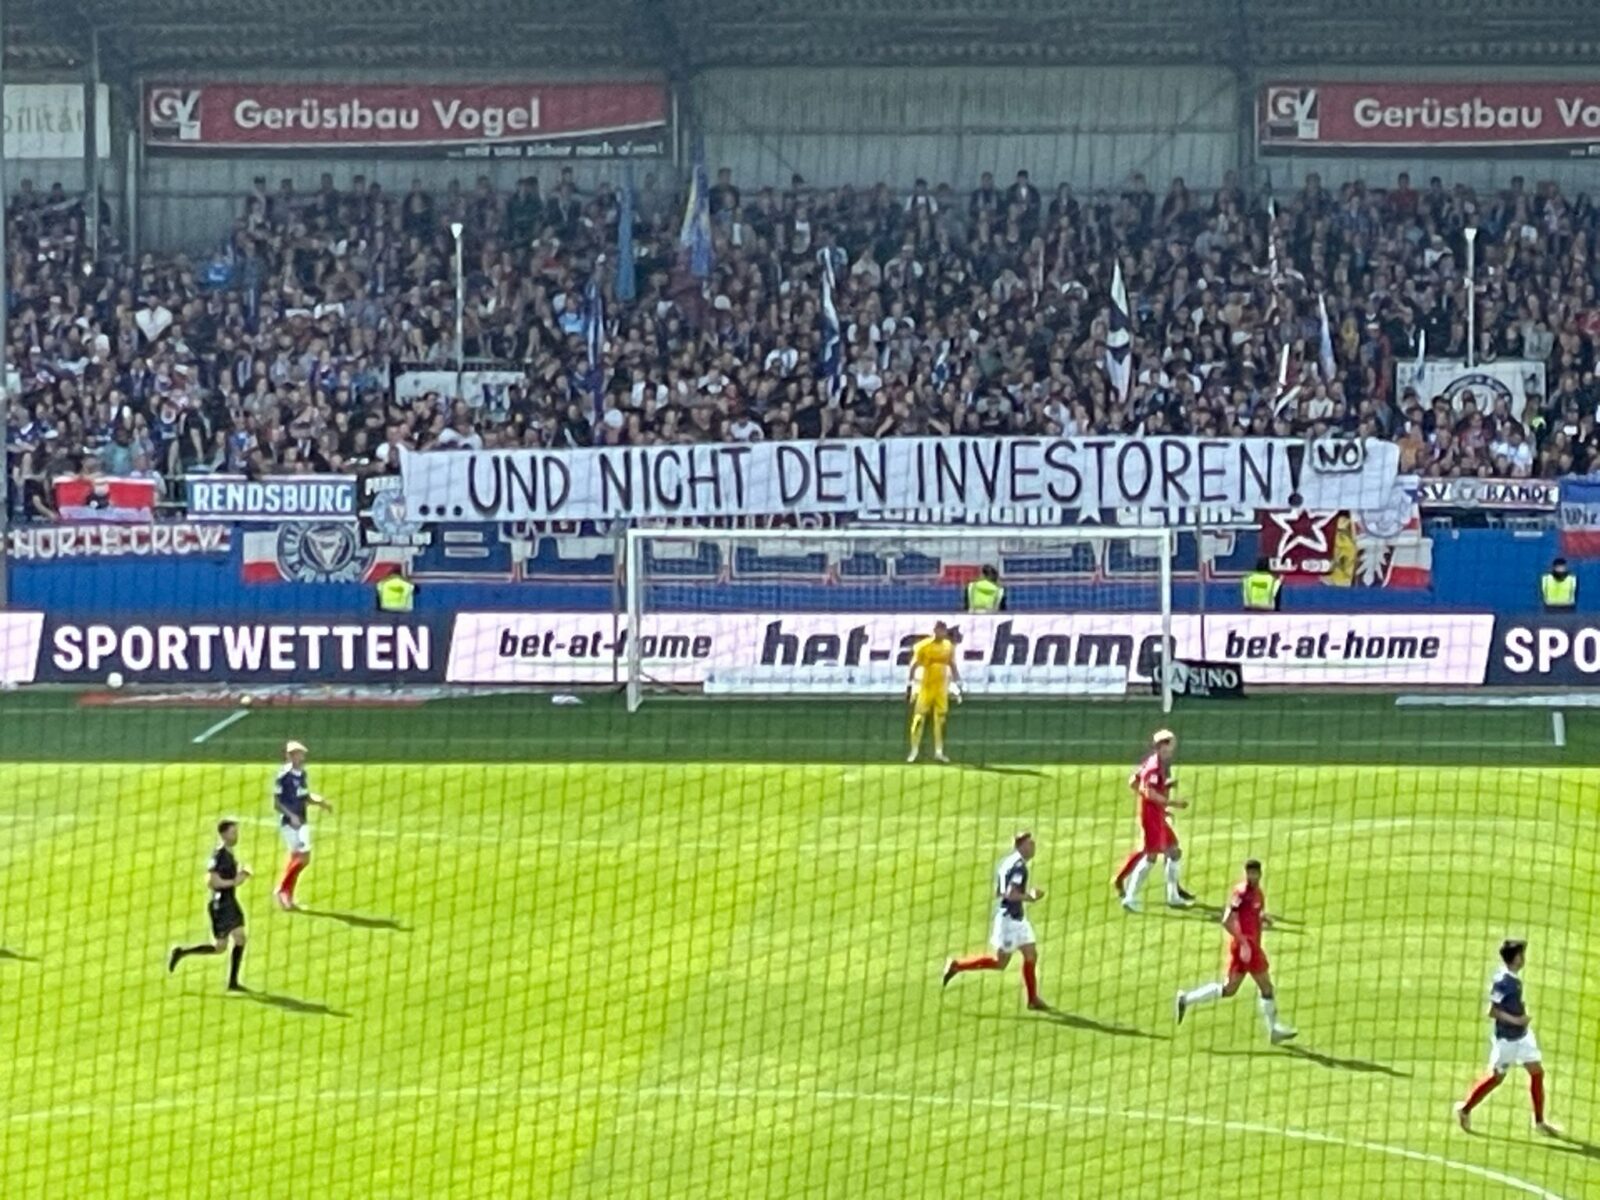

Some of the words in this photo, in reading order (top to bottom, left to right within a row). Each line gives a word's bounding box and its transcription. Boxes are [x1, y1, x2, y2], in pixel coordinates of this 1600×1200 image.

[234, 97, 420, 130] Gerüstbau
[433, 97, 540, 136] Vogel
[1354, 97, 1541, 128] Gerüstbau
[1317, 442, 1358, 467] NO
[600, 446, 751, 512] NICHT
[777, 444, 886, 506] DEN
[193, 483, 352, 513] RENDSBURG
[53, 626, 429, 671] SPORTWETTEN
[1225, 629, 1440, 658] bet-at-home
